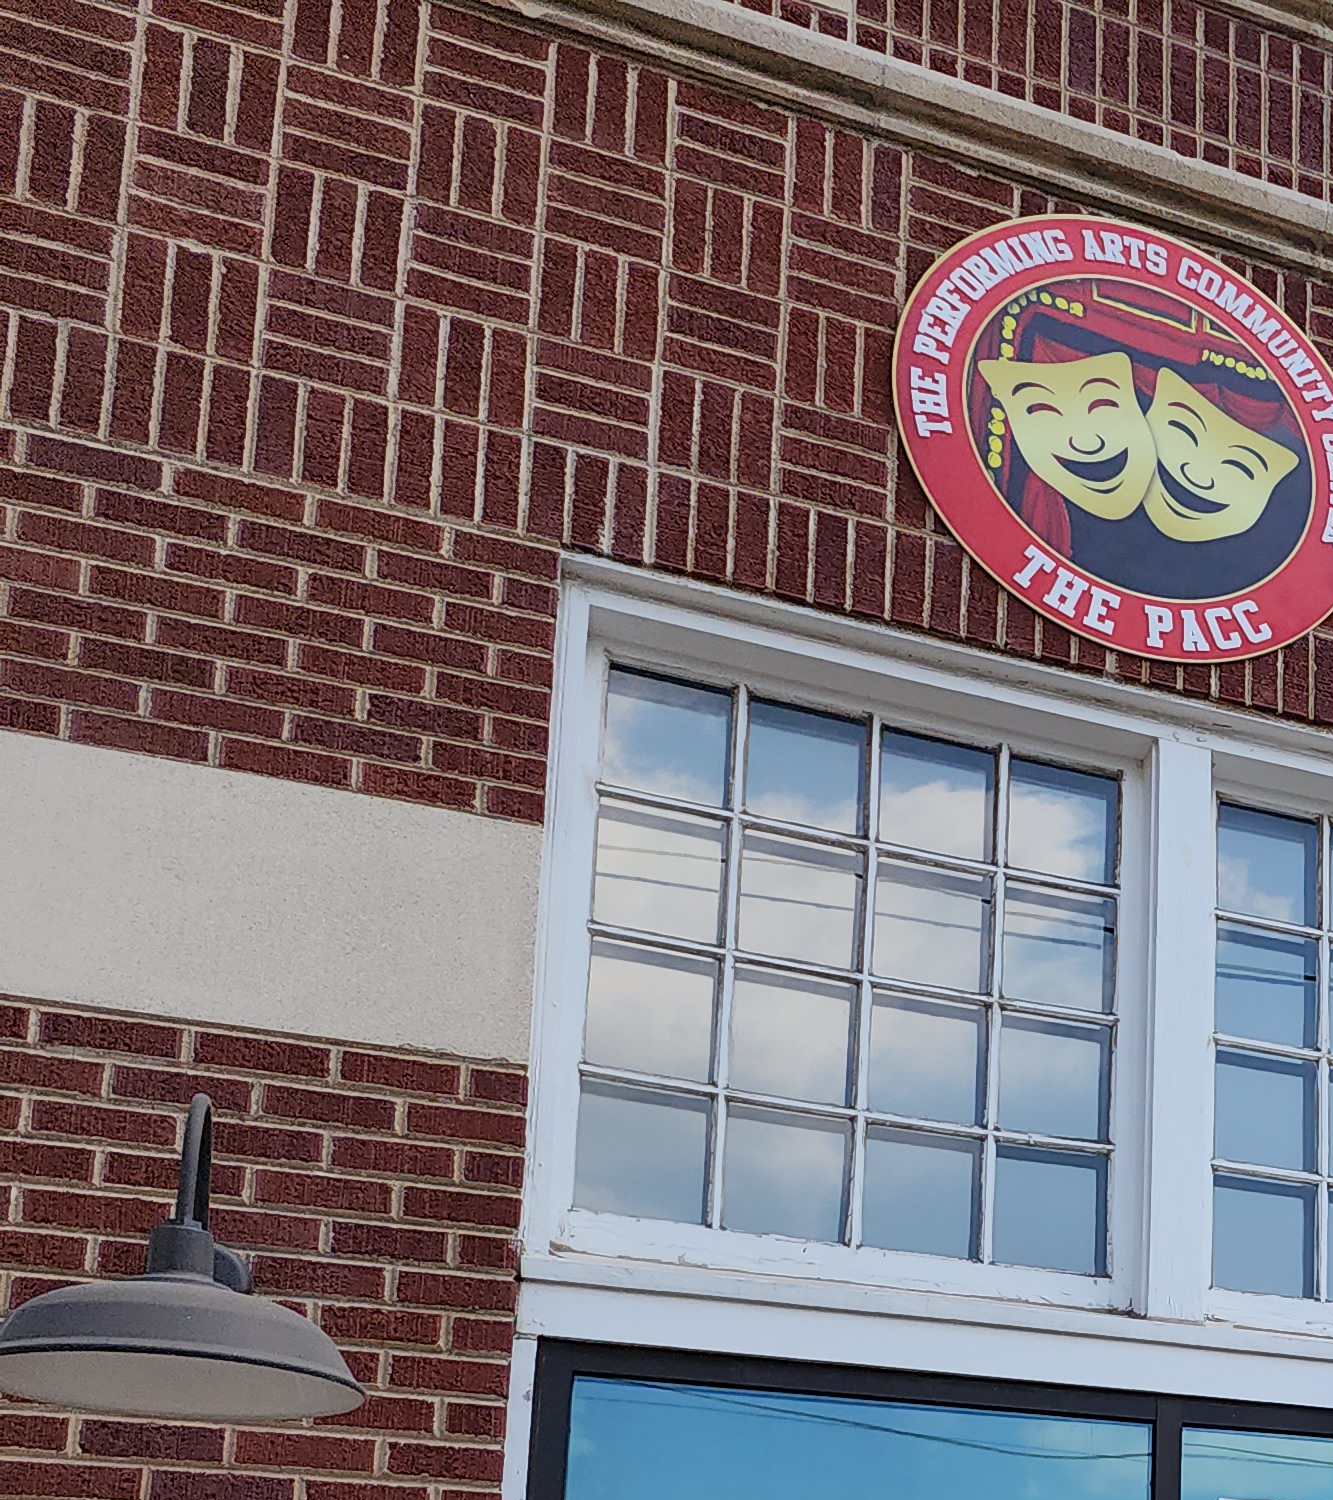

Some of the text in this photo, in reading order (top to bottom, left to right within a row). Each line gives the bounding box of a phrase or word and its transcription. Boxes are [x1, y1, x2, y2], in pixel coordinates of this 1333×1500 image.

[914, 229, 1073, 365] PERFORMING
[1082, 229, 1168, 276] ARTS
[911, 367, 952, 438] THE
[1013, 545, 1273, 652] THE PACC
